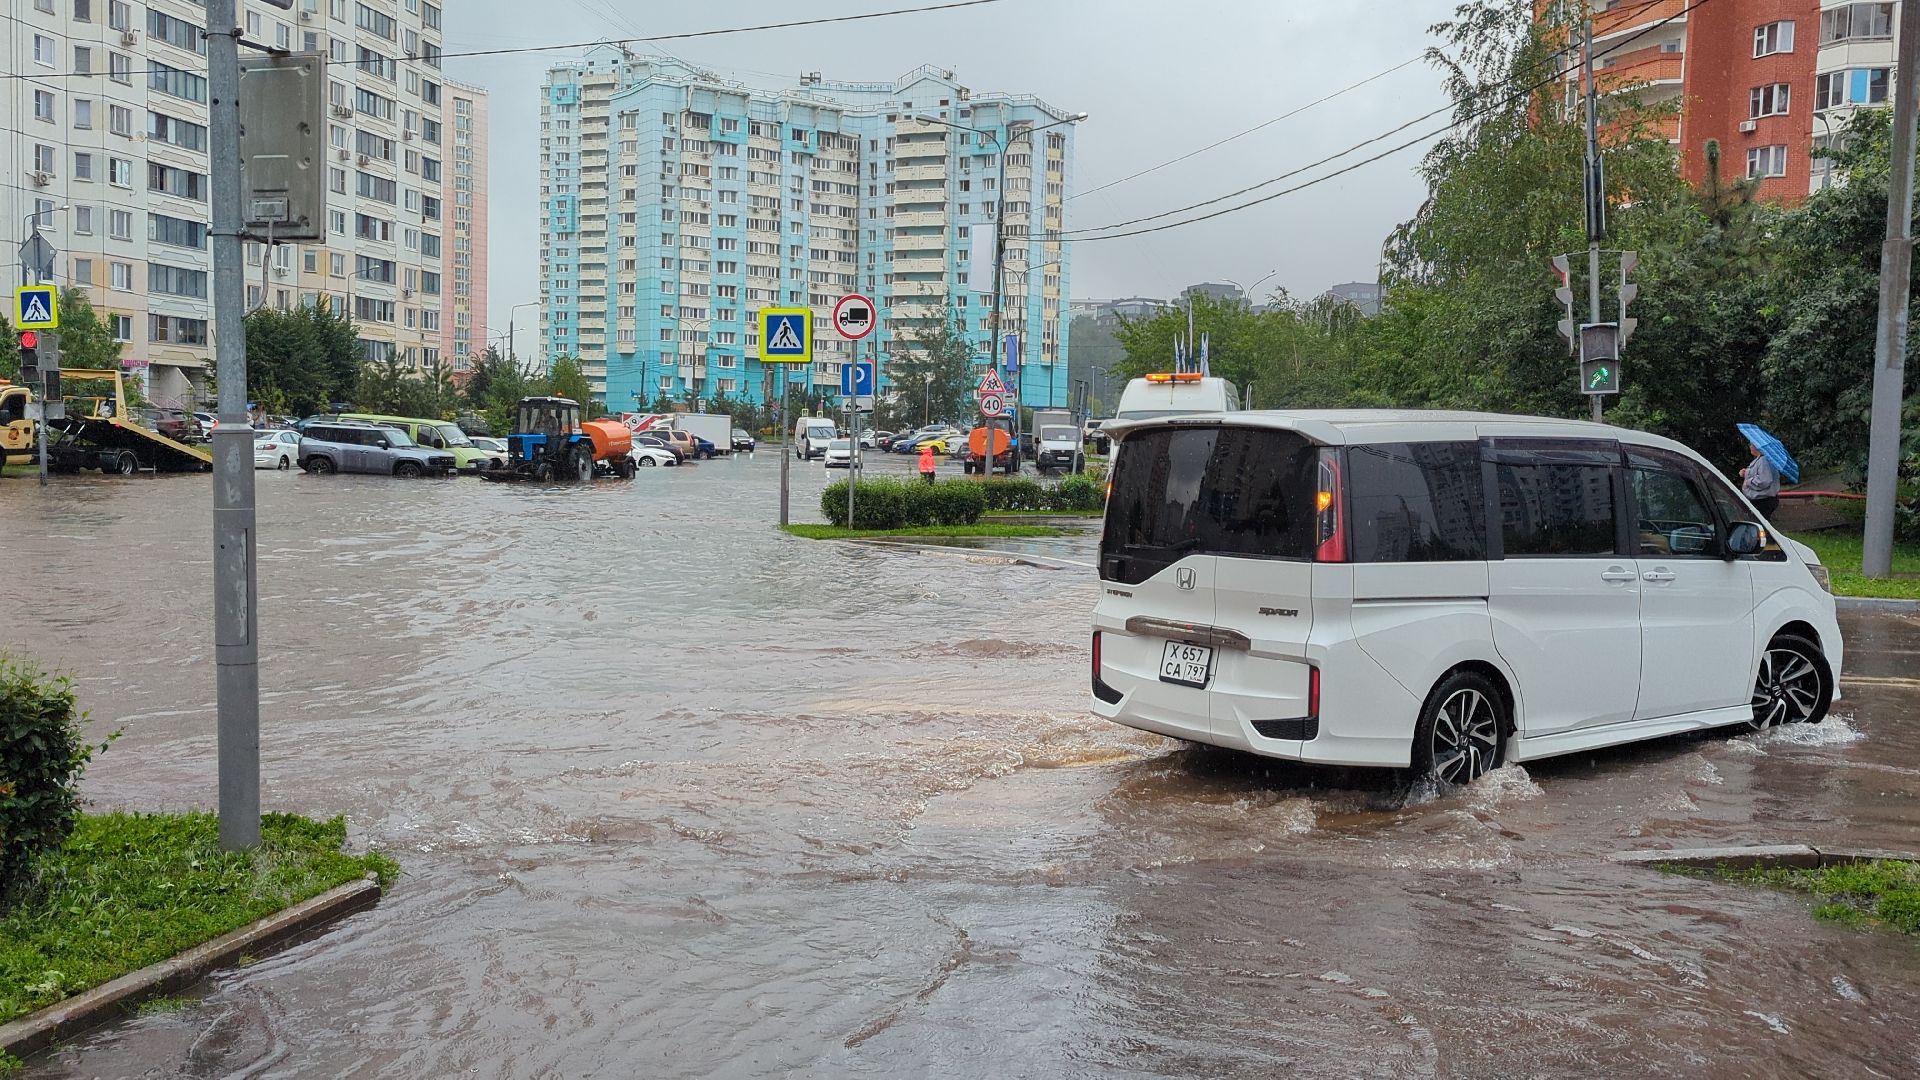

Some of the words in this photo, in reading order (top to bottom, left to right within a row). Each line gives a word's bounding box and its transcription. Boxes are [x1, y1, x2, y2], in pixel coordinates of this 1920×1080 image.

[848, 366, 865, 393] P
[984, 400, 1000, 411] 40
[1182, 646, 1204, 662] 657
[1187, 664, 1205, 678] 797
